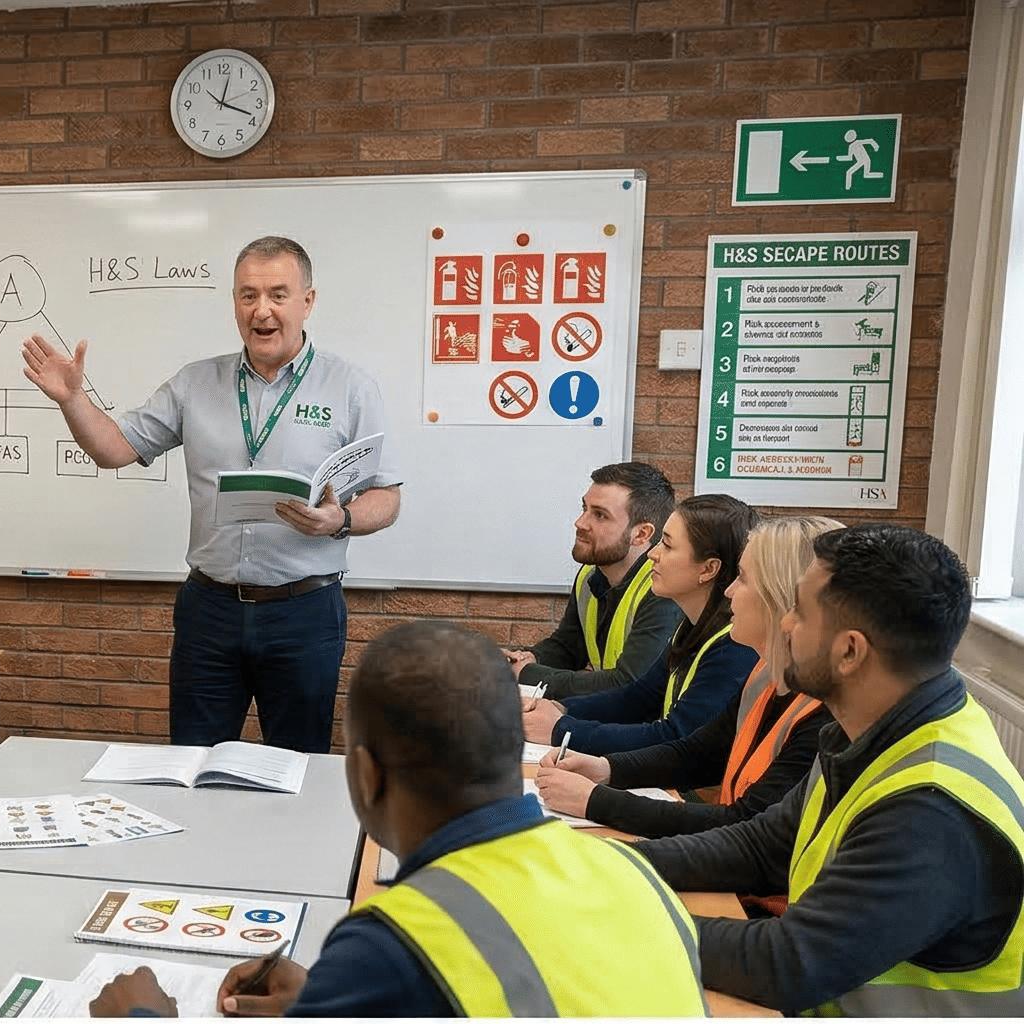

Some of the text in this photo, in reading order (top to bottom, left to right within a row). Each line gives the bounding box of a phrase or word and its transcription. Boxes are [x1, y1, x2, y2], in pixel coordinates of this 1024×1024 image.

[217, 63, 231, 75] 12
[188, 82, 201, 94] 10
[250, 80, 258, 91] 2
[184, 100, 192, 111] 9
[255, 98, 263, 109] 3
[189, 117, 196, 129] 8
[248, 116, 256, 127] 4
[202, 130, 210, 142] 7
[217, 134, 226, 146] 6
[235, 129, 244, 141] 5
[723, 244, 901, 264] H&S SECAPE ROUTES
[88, 256, 212, 283] H&S Laws
[0, 272, 23, 307] A
[724, 286, 733, 303] 1
[720, 321, 734, 338] 2
[719, 356, 732, 373] 3
[717, 391, 730, 407] 4
[295, 403, 332, 421] H&S
[715, 425, 728, 442] 5
[713, 456, 726, 473] 6
[860, 487, 887, 500] HSA
